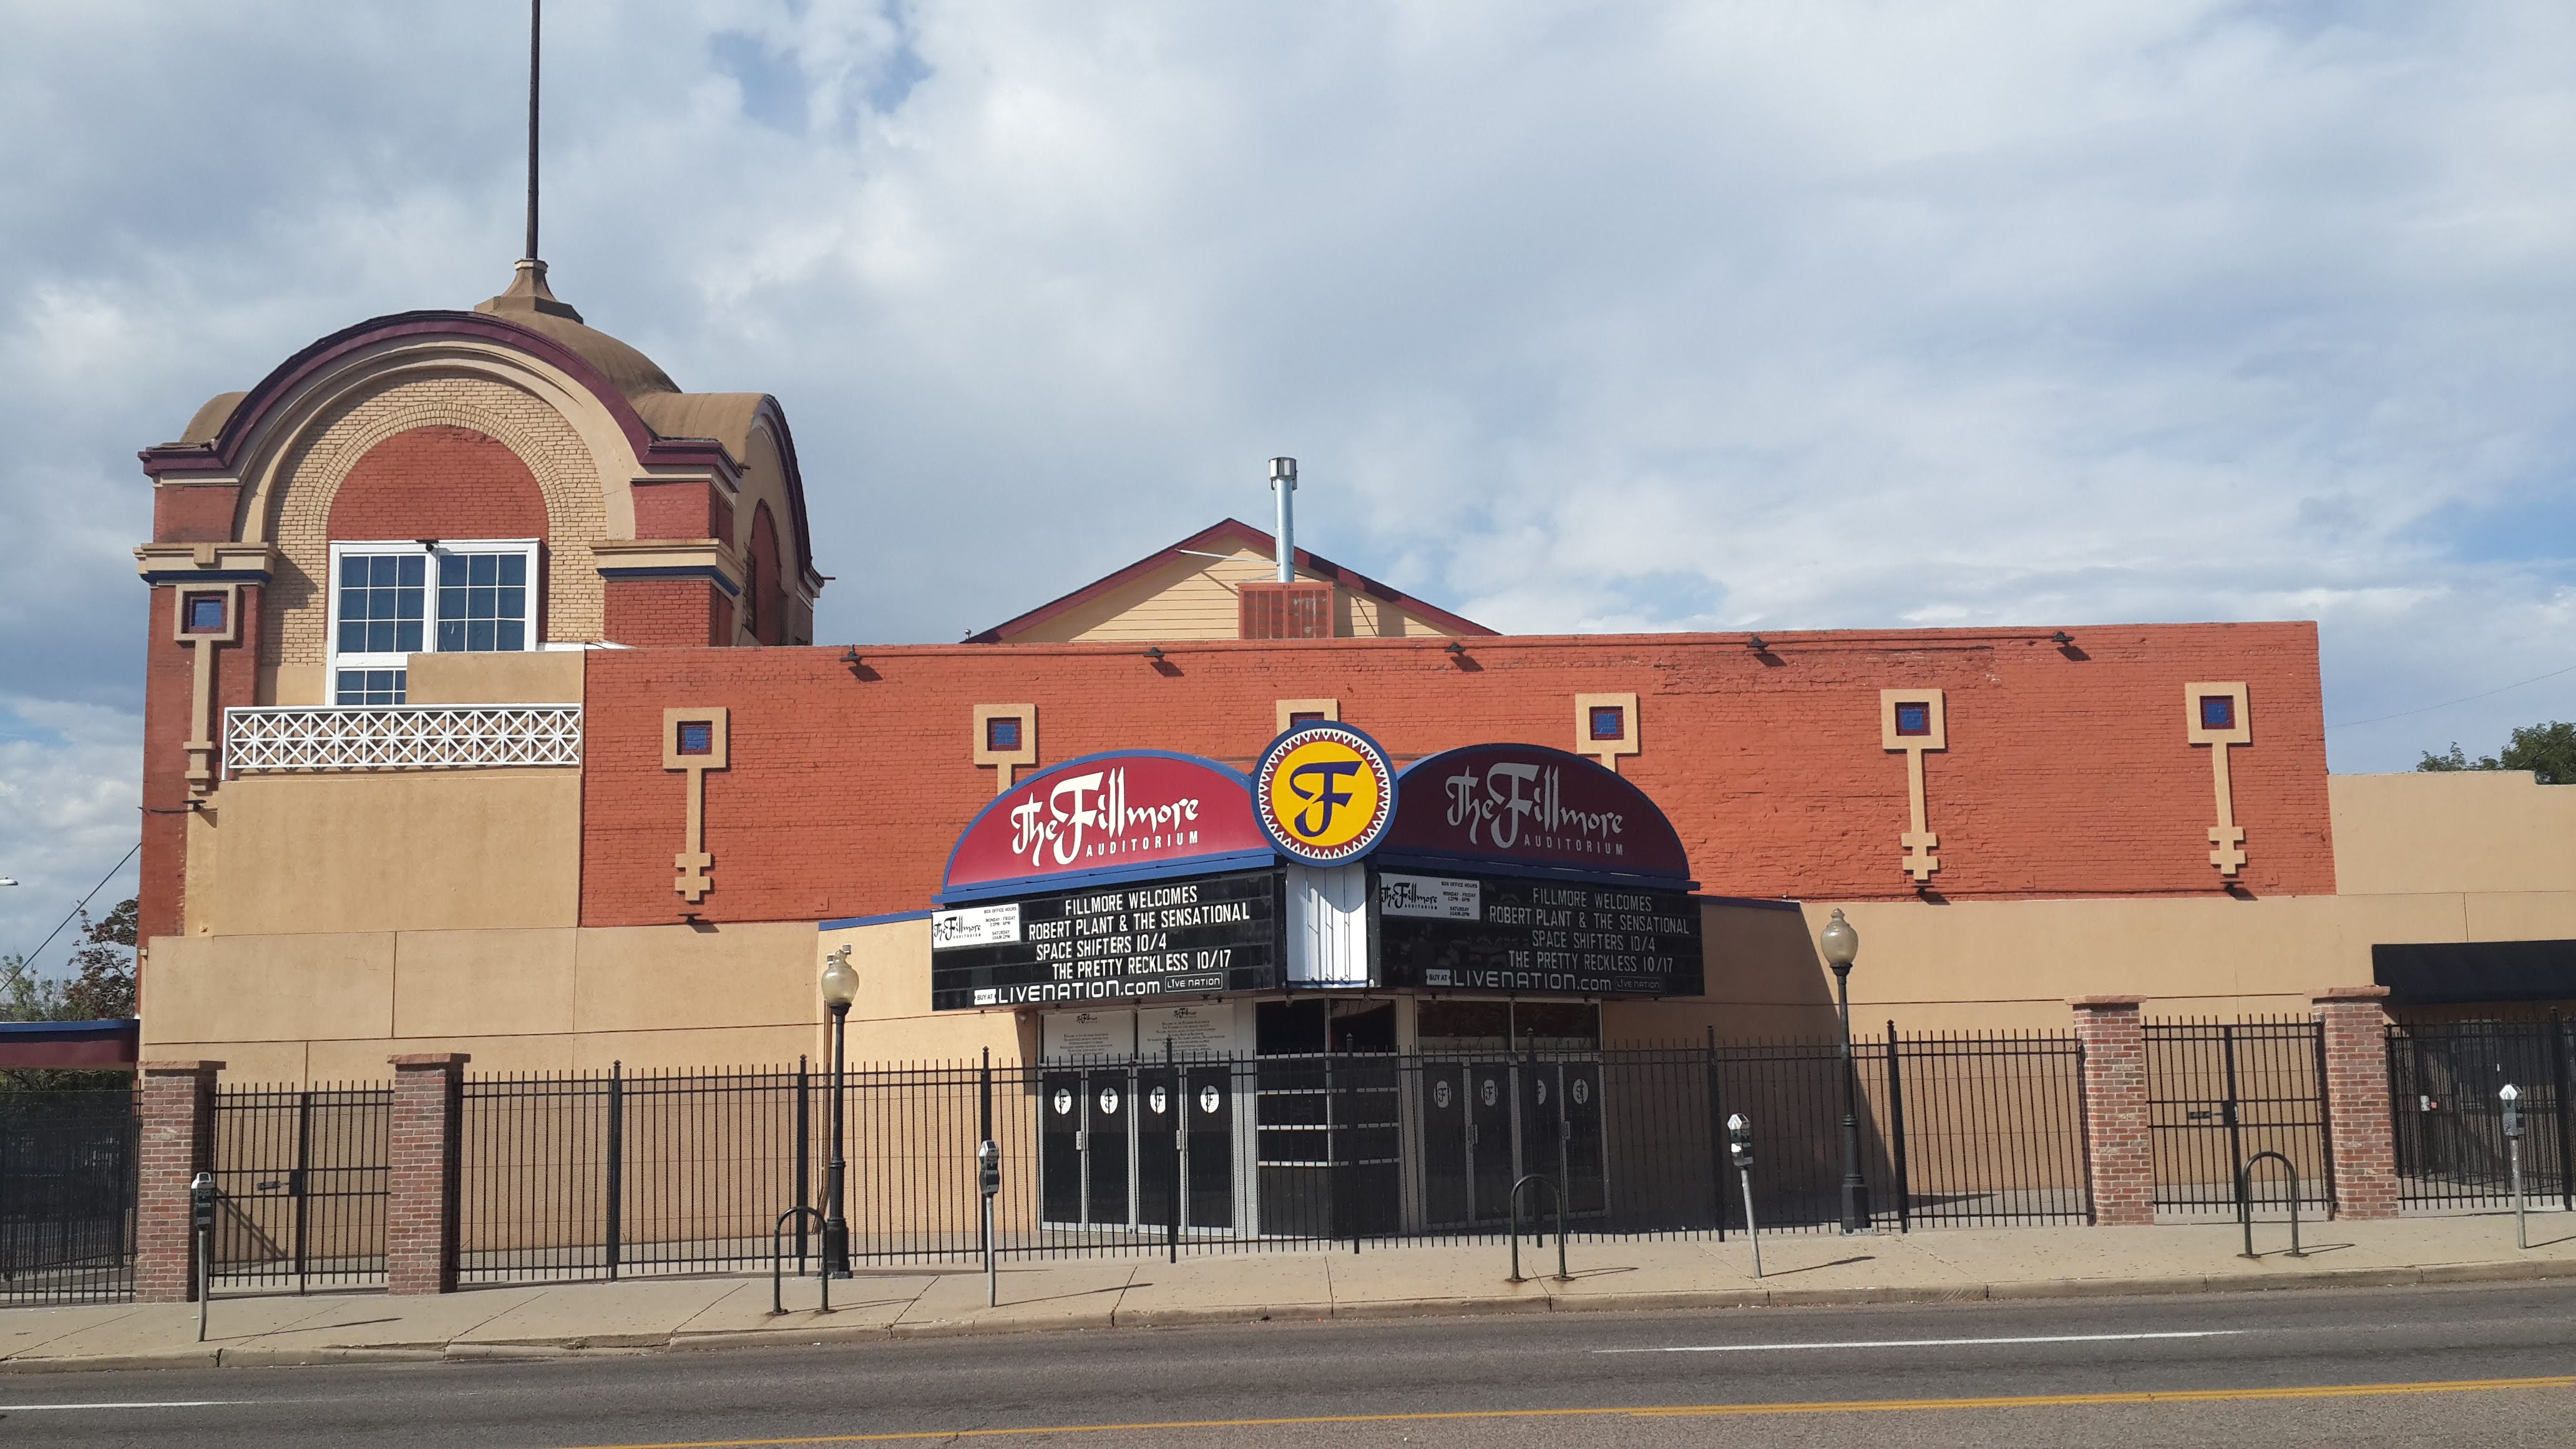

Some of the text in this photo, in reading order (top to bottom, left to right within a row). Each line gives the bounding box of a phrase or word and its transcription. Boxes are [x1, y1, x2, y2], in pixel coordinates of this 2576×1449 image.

[1289, 761, 1363, 837] F
[1445, 763, 1622, 849] The Fillmore
[1011, 766, 1199, 866] The Fillmore
[1086, 831, 1198, 857] AUDITORIUM
[1524, 834, 1622, 855] AUDITORIUM
[1065, 886, 1198, 916] FILLMORE WELCOMES
[1381, 882, 1438, 909] The Fillmore
[1533, 887, 1652, 912] FILLMORE WELCOMES
[934, 915, 981, 941] The Fillmore
[1029, 902, 1250, 940] ROBERT PLANT & THE SENSATIONAL
[1490, 905, 1690, 934] ROBERT PLANT & THE SENSATIONAL
[1037, 932, 1166, 961] SPACE SHIFTERS 10/4
[1532, 930, 1655, 952] SPACE SHIFTERS 10/4
[1052, 949, 1231, 980] THE PRETTY RECKLESS 10/17
[1508, 950, 1673, 973] THE PRETTY RECKLESS 10/17
[1168, 978, 1221, 988] LIVE NATION
[1617, 979, 1632, 988] LIVE
